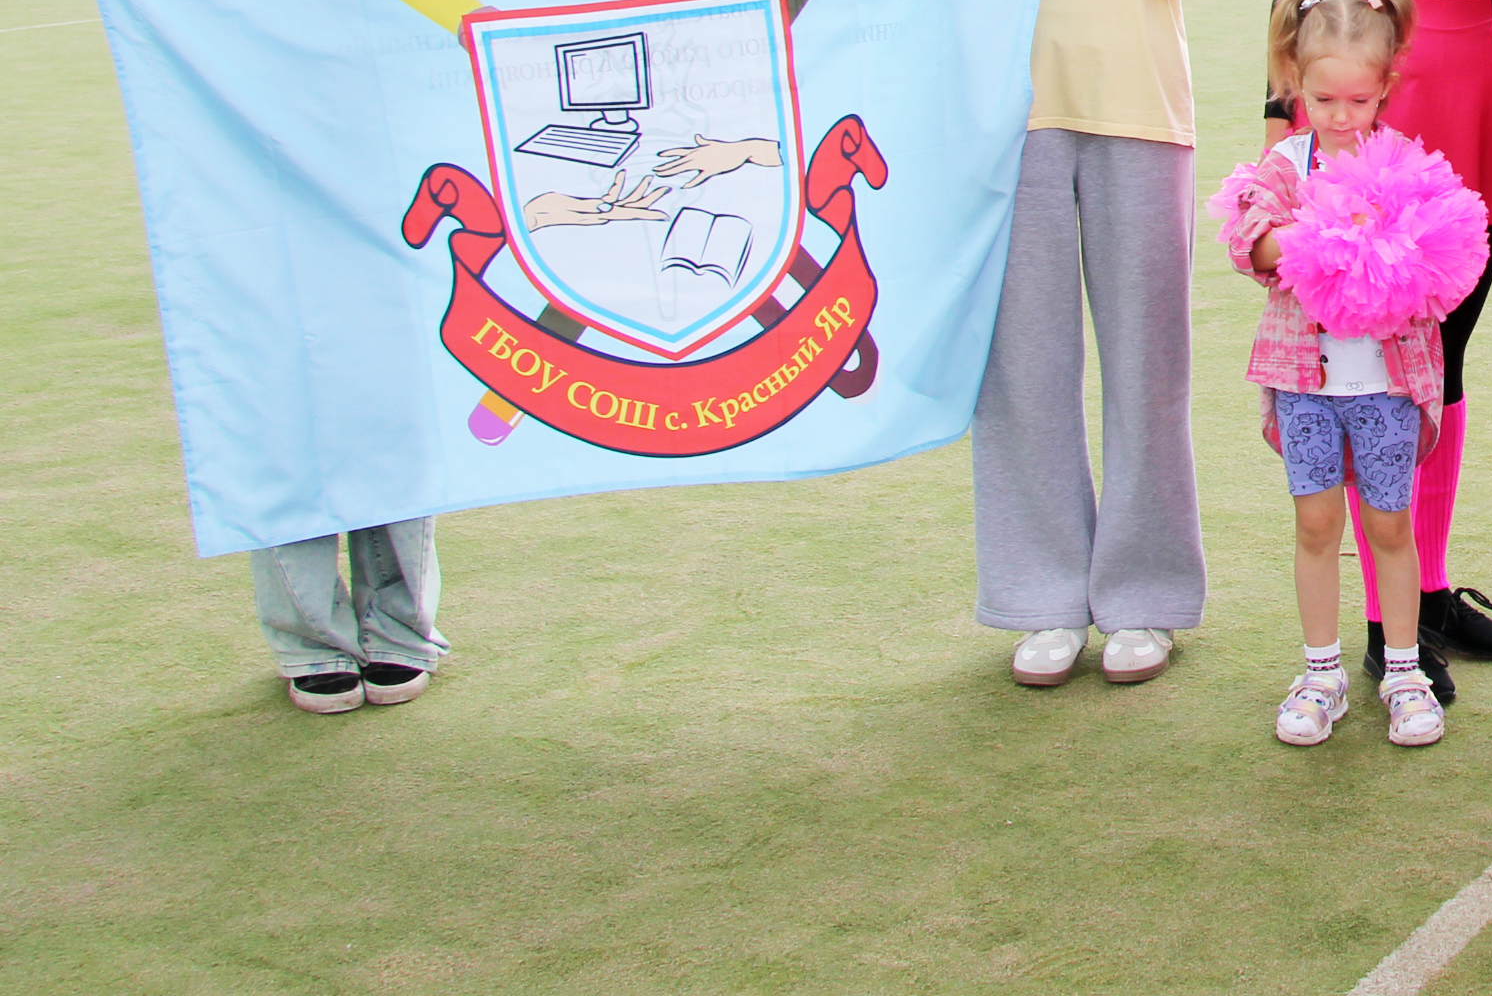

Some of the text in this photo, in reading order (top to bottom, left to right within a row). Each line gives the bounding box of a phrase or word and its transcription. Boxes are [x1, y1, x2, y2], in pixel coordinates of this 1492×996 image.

[471, 296, 856, 431] ГБОУ СОШ с. Красный Яр
